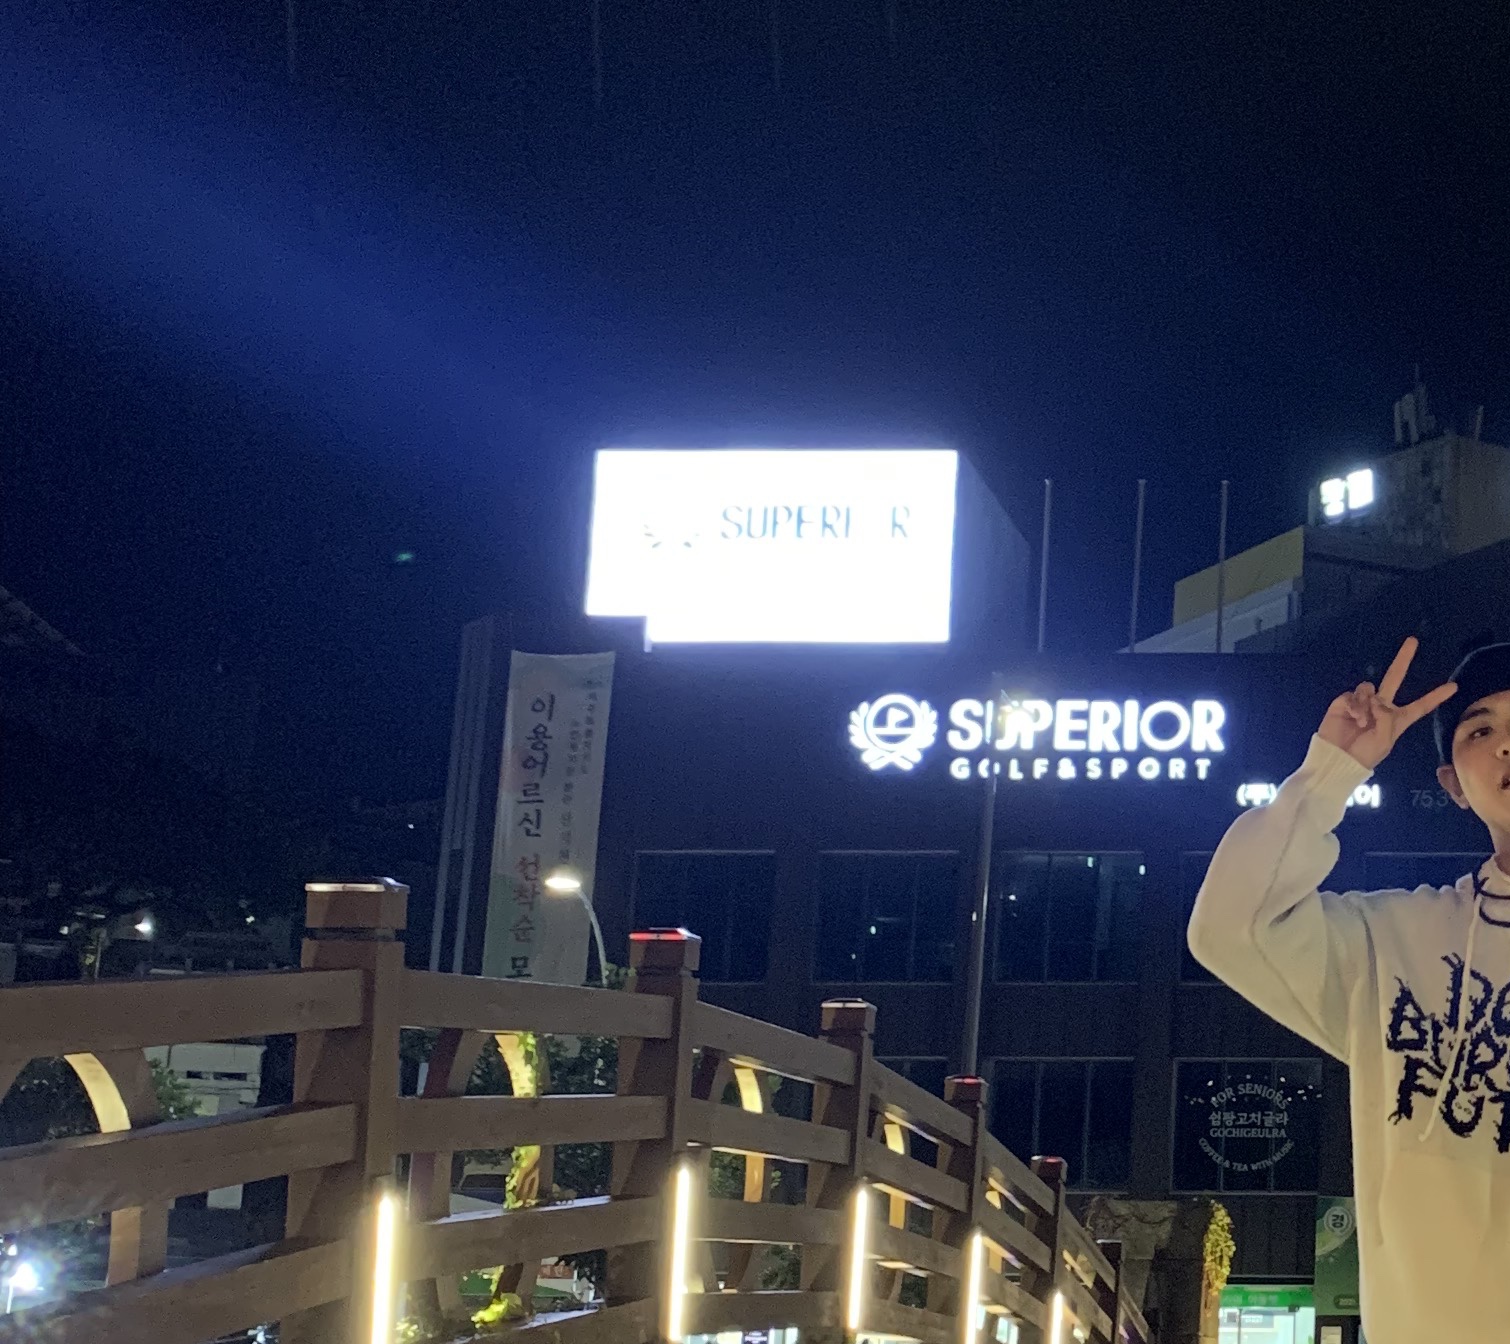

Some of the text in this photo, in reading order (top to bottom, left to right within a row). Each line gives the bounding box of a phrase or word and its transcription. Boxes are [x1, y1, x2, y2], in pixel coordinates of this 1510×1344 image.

[720, 505, 911, 539] SUPERIR
[947, 698, 1226, 754] SUPERIOR
[1210, 1083, 1290, 1110] FOR SENIORS
[1209, 1127, 1287, 1138] GOCHIGEULRA
[1232, 1162, 1249, 1172] TEA
[1250, 1159, 1274, 1171] WITH
